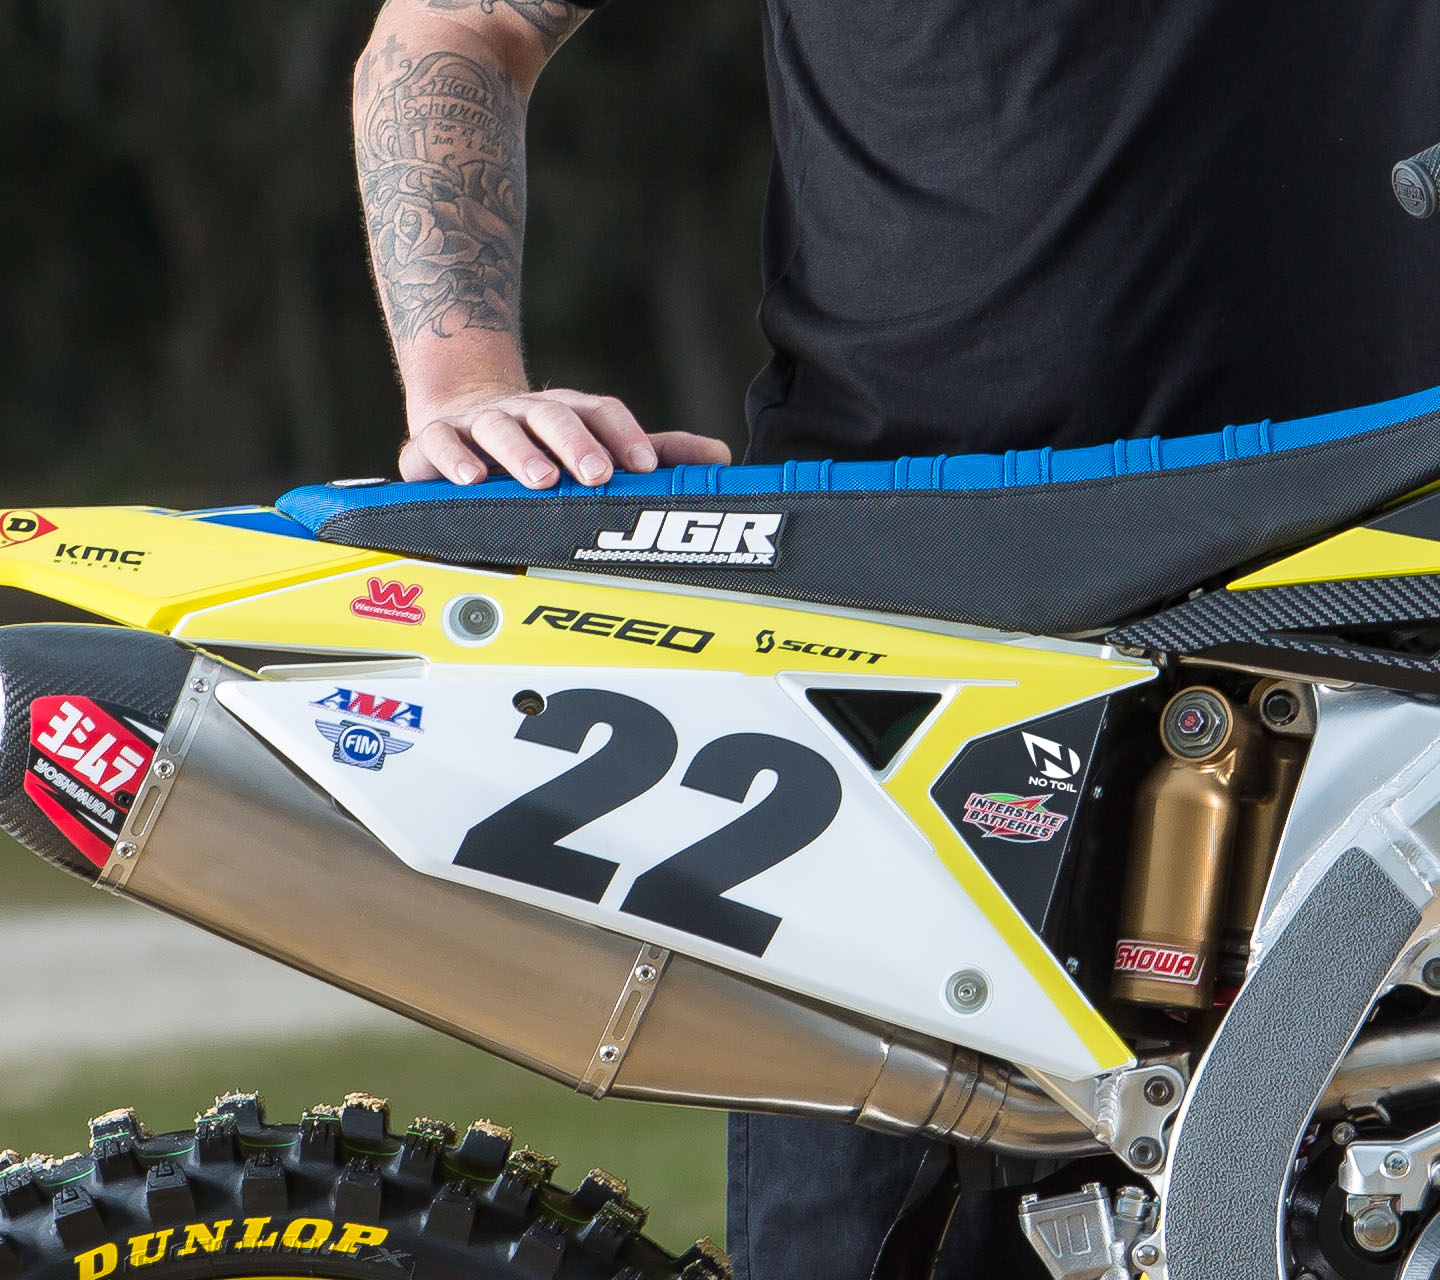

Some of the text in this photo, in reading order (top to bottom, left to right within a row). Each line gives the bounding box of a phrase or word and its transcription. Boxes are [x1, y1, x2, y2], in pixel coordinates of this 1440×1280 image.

[597, 510, 784, 554] JGR
[728, 552, 776, 565] MX
[522, 605, 715, 654] REED
[777, 639, 888, 664] SCOTT
[311, 686, 424, 731] AMA
[37, 701, 145, 793] ヨシムラ
[345, 734, 379, 755] FIM
[33, 758, 117, 824] YOSHIMURA
[1028, 776, 1077, 793] NO TOIL
[452, 687, 843, 959] 22
[968, 809, 1052, 838] BATTERIES
[970, 796, 1061, 828] INTERSTATE
[1115, 943, 1197, 977] SHOWA
